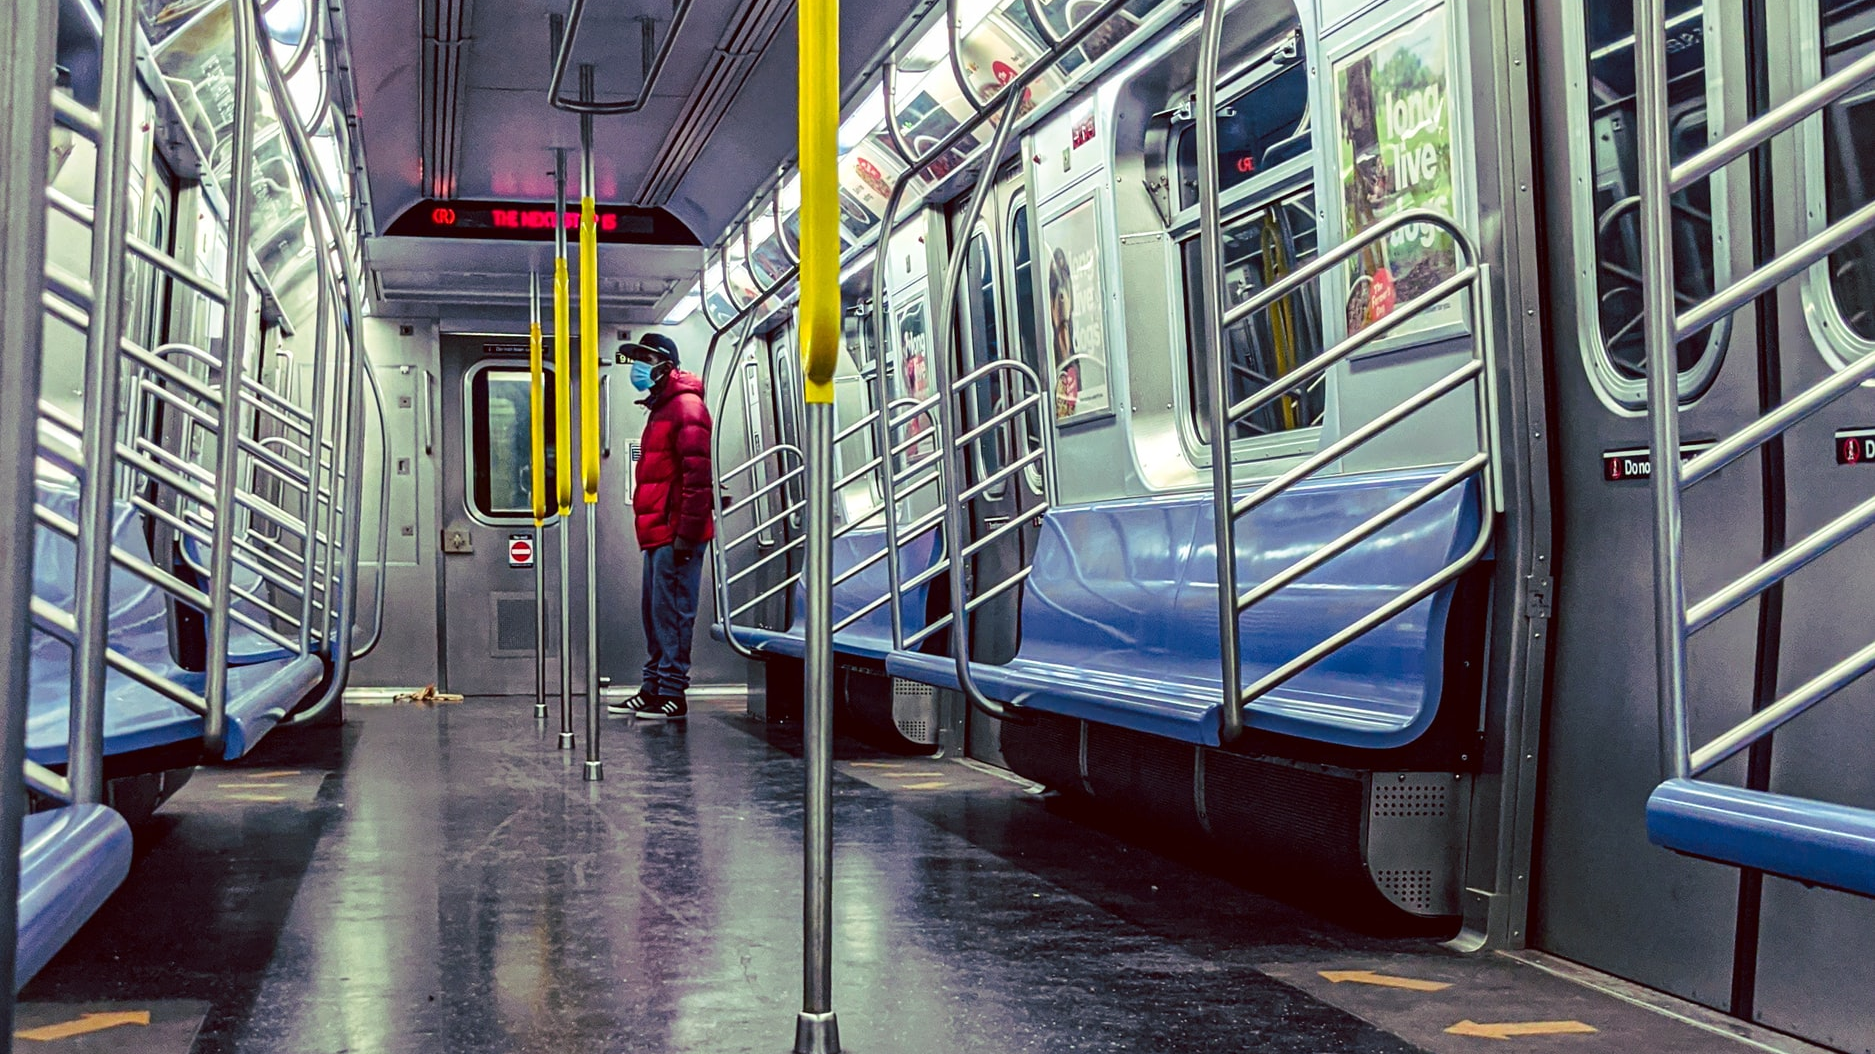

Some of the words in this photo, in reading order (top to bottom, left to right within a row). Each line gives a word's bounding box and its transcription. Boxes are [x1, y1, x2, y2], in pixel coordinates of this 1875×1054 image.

[1385, 83, 1439, 141] long
[1393, 142, 1437, 191] live
[432, 208, 456, 224] (R)
[492, 210, 518, 228] THE
[520, 211, 556, 229] NEXT
[602, 213, 617, 231] IS
[1624, 460, 1638, 475] Do
[1639, 462, 1651, 475] no
